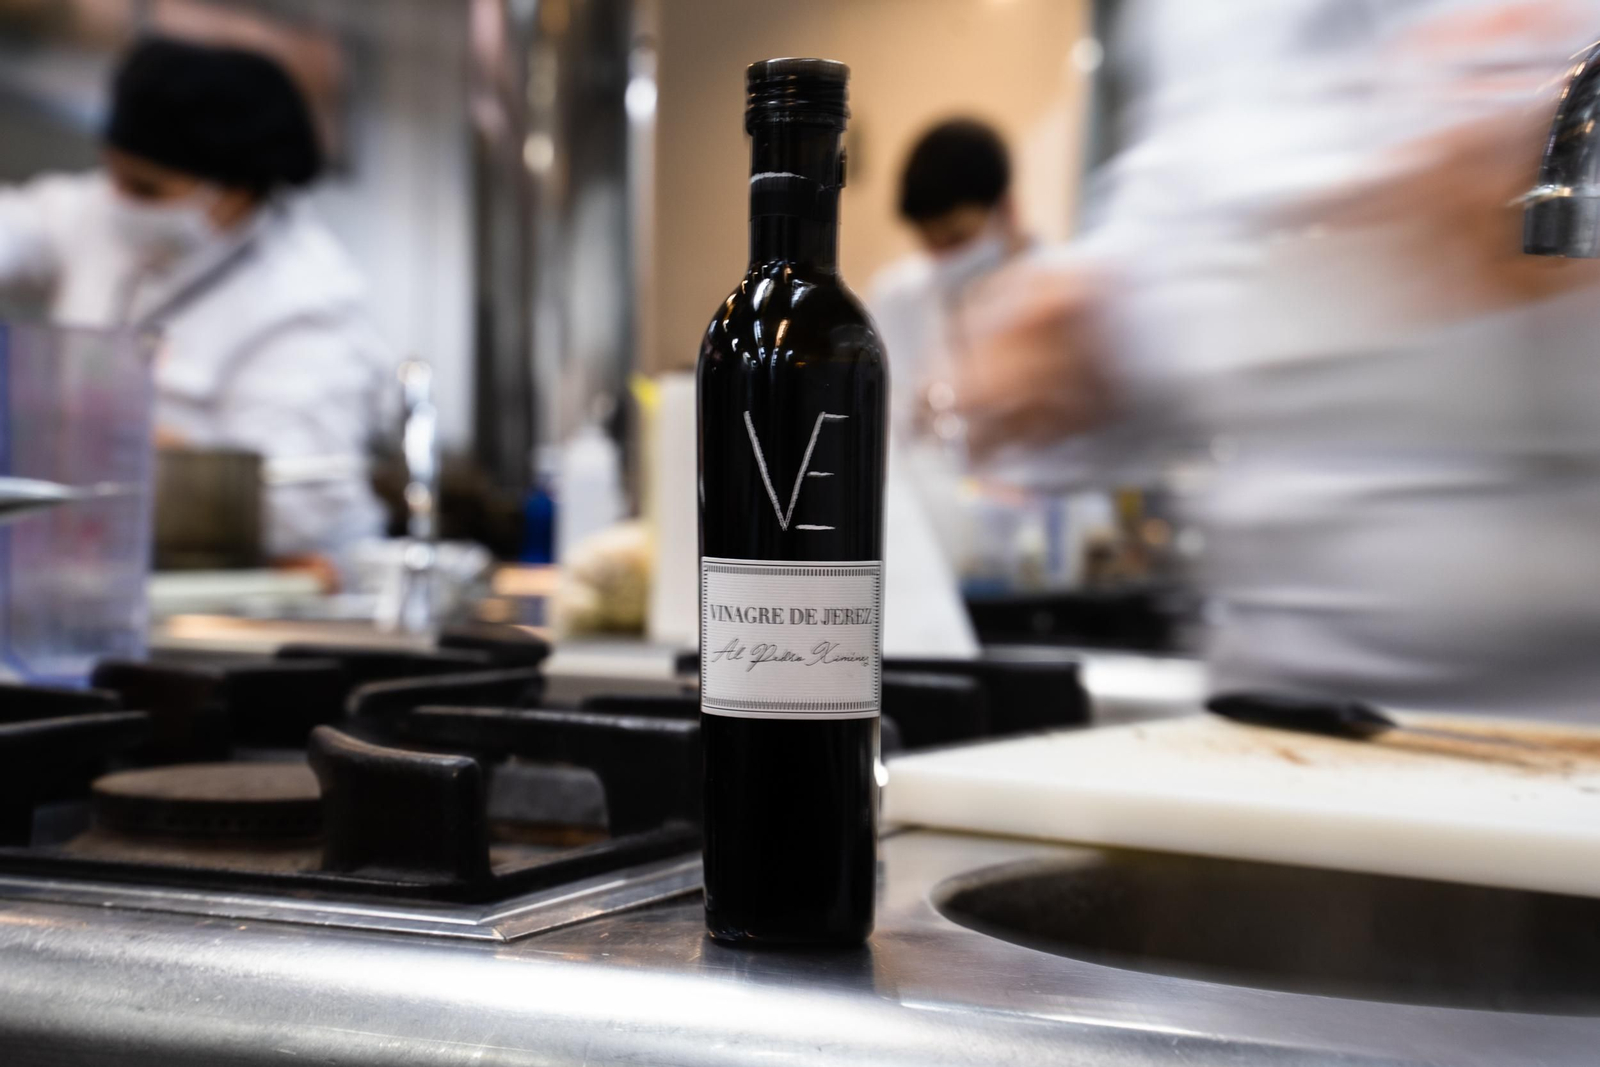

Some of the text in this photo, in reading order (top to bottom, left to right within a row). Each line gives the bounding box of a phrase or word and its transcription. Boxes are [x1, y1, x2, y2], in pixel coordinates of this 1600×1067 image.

[710, 604, 872, 626] VINAGRE DE JEREZ
[711, 638, 745, 663] Al
[745, 643, 804, 672] Pedro
